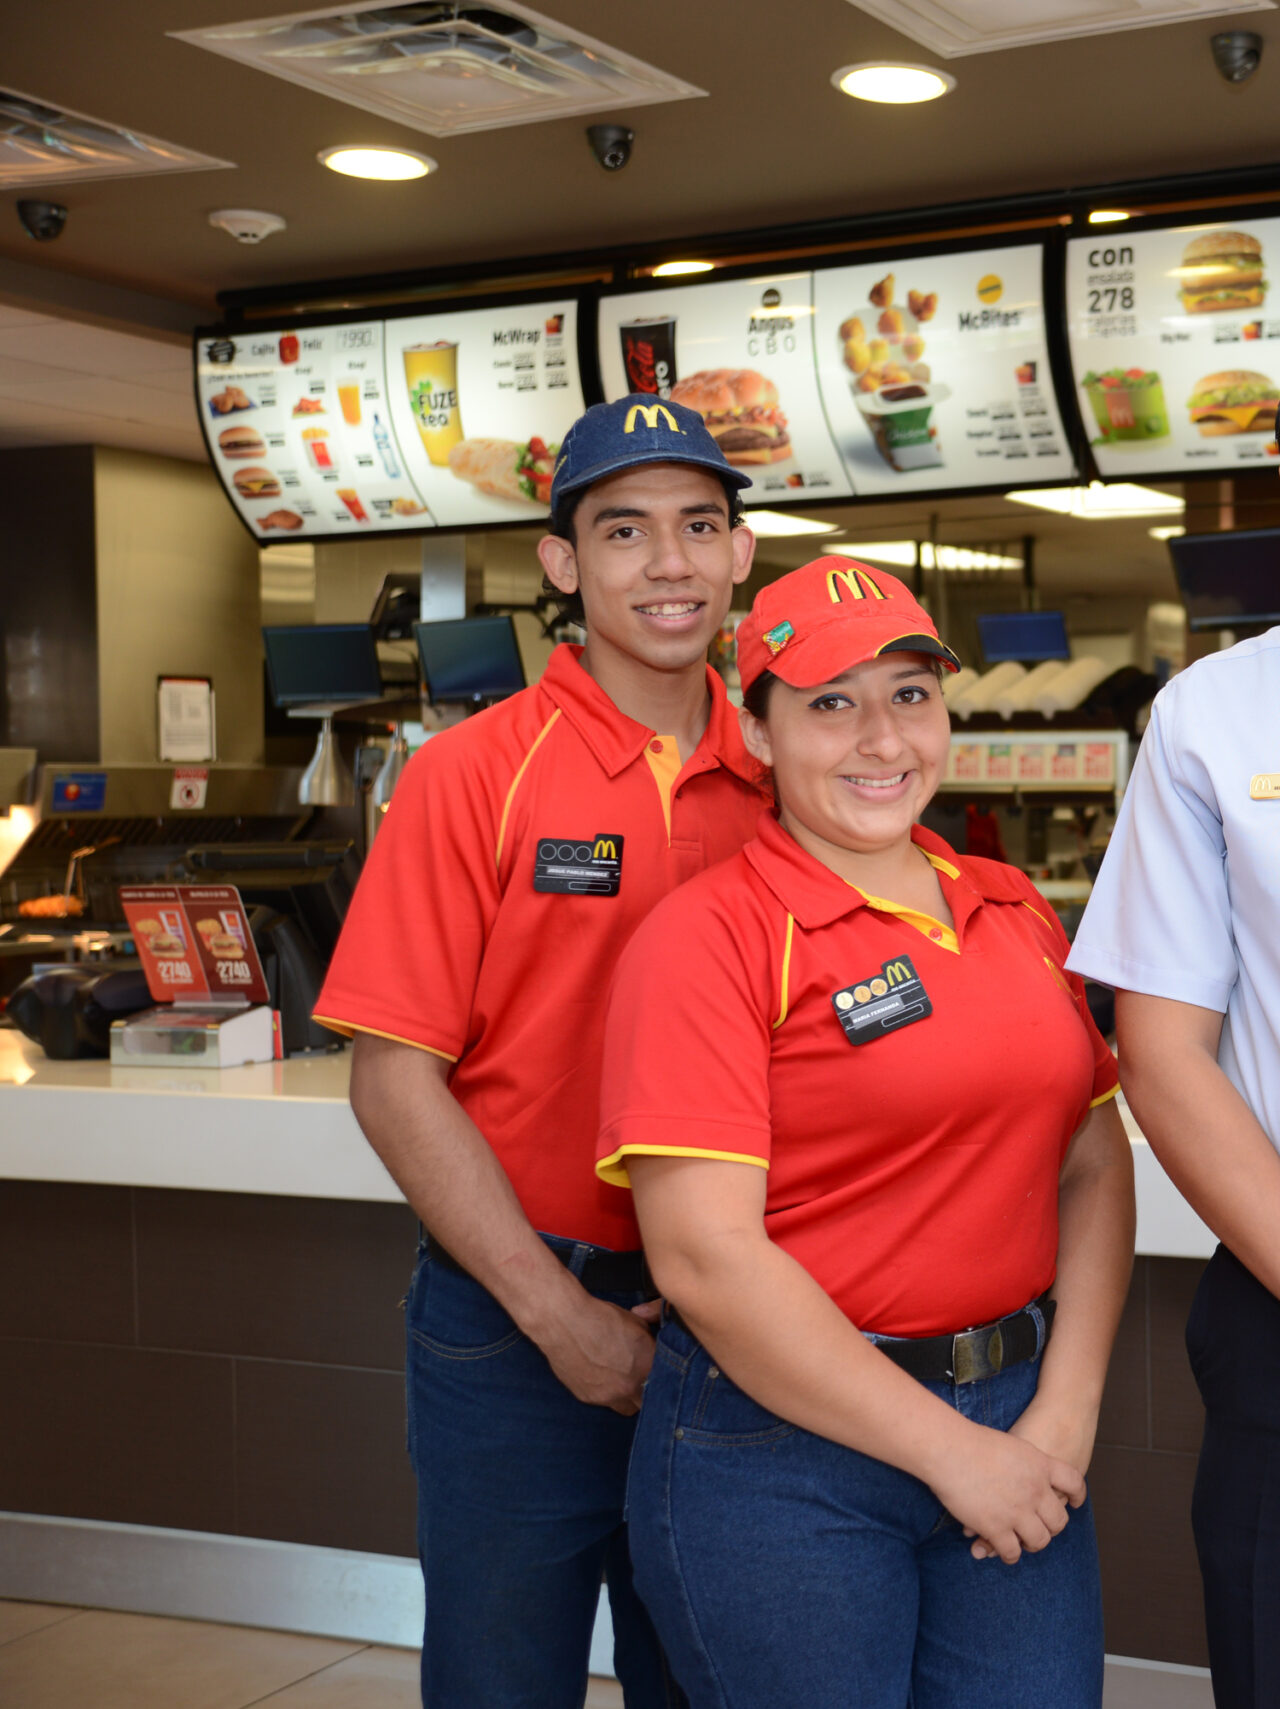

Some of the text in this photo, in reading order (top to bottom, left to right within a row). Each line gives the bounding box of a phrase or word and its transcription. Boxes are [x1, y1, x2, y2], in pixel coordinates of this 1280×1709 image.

[1088, 246, 1134, 268] con
[1088, 286, 1135, 313] 278
[493, 329, 541, 347] McWrap
[419, 390, 457, 410] FUZE
[422, 411, 449, 427] tea
[870, 1001, 900, 1017] FERNANDA
